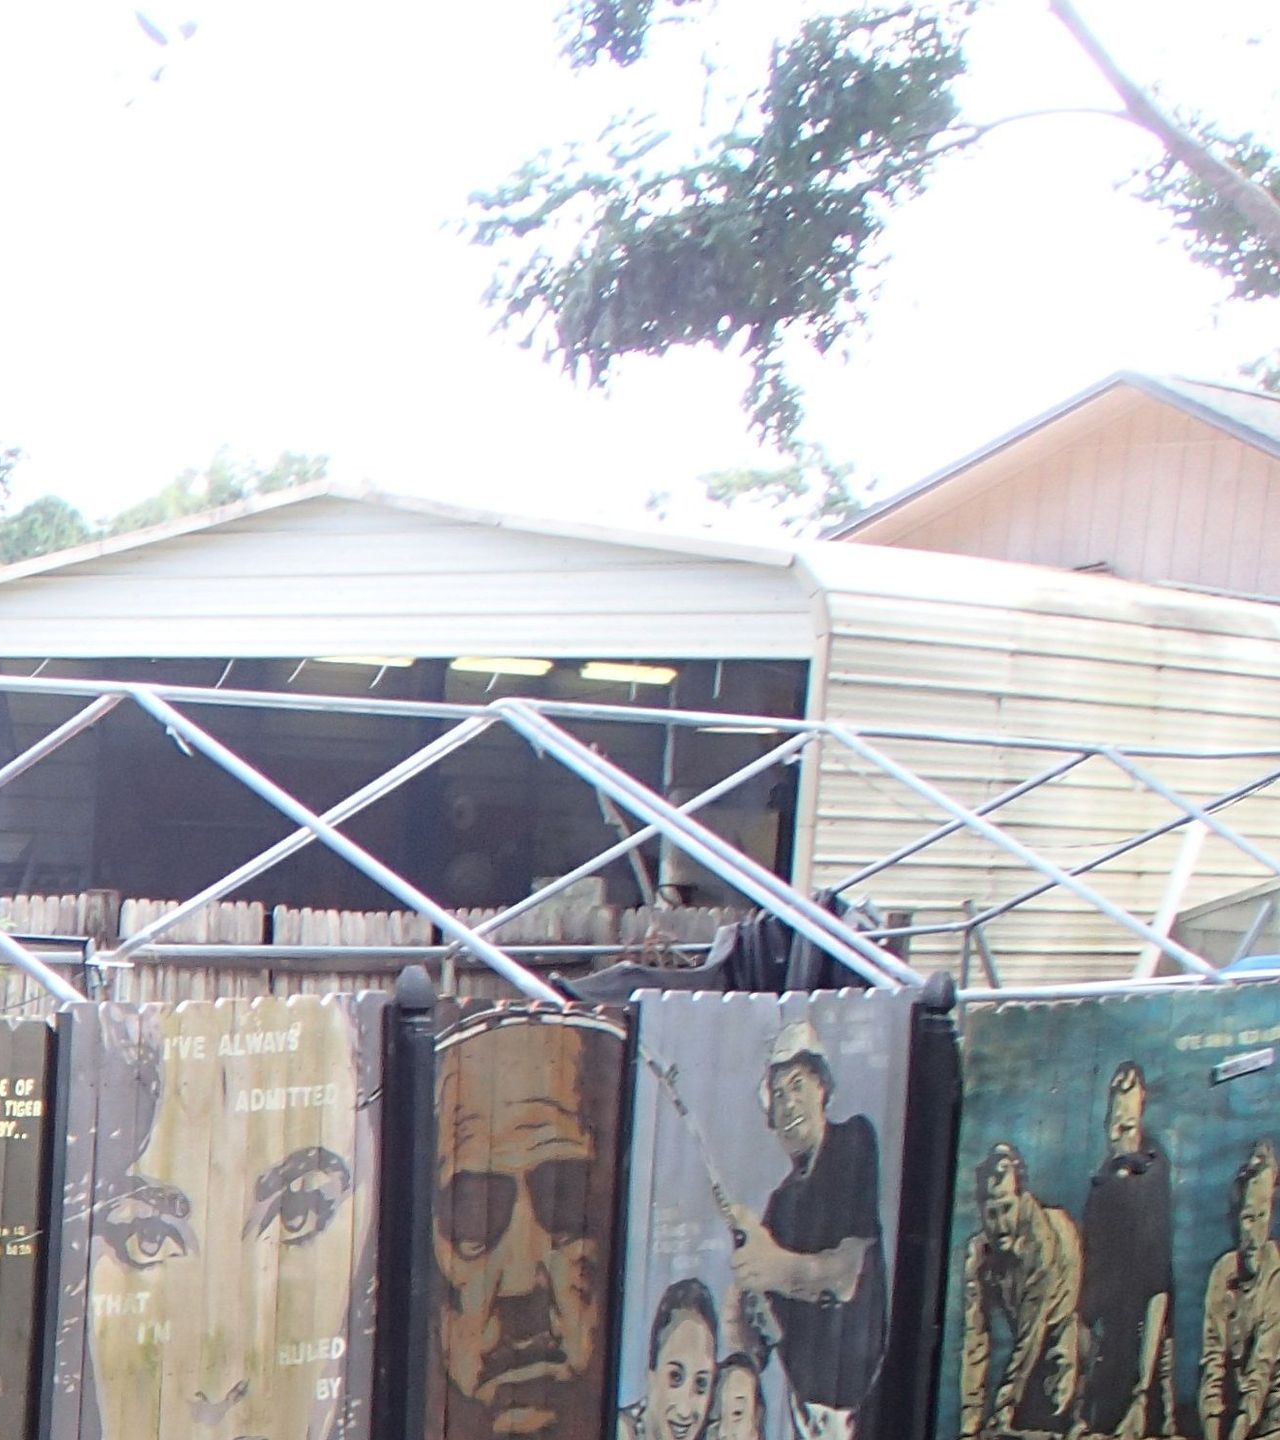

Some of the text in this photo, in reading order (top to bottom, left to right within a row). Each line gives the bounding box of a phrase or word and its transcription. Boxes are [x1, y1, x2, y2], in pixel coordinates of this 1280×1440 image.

[163, 1022, 302, 1060] I'VE ALWAYS
[15, 1078, 35, 1097] OF
[233, 1083, 339, 1113] ADMITTED
[5, 1100, 42, 1118] TIGER
[316, 1376, 343, 1401] BY
